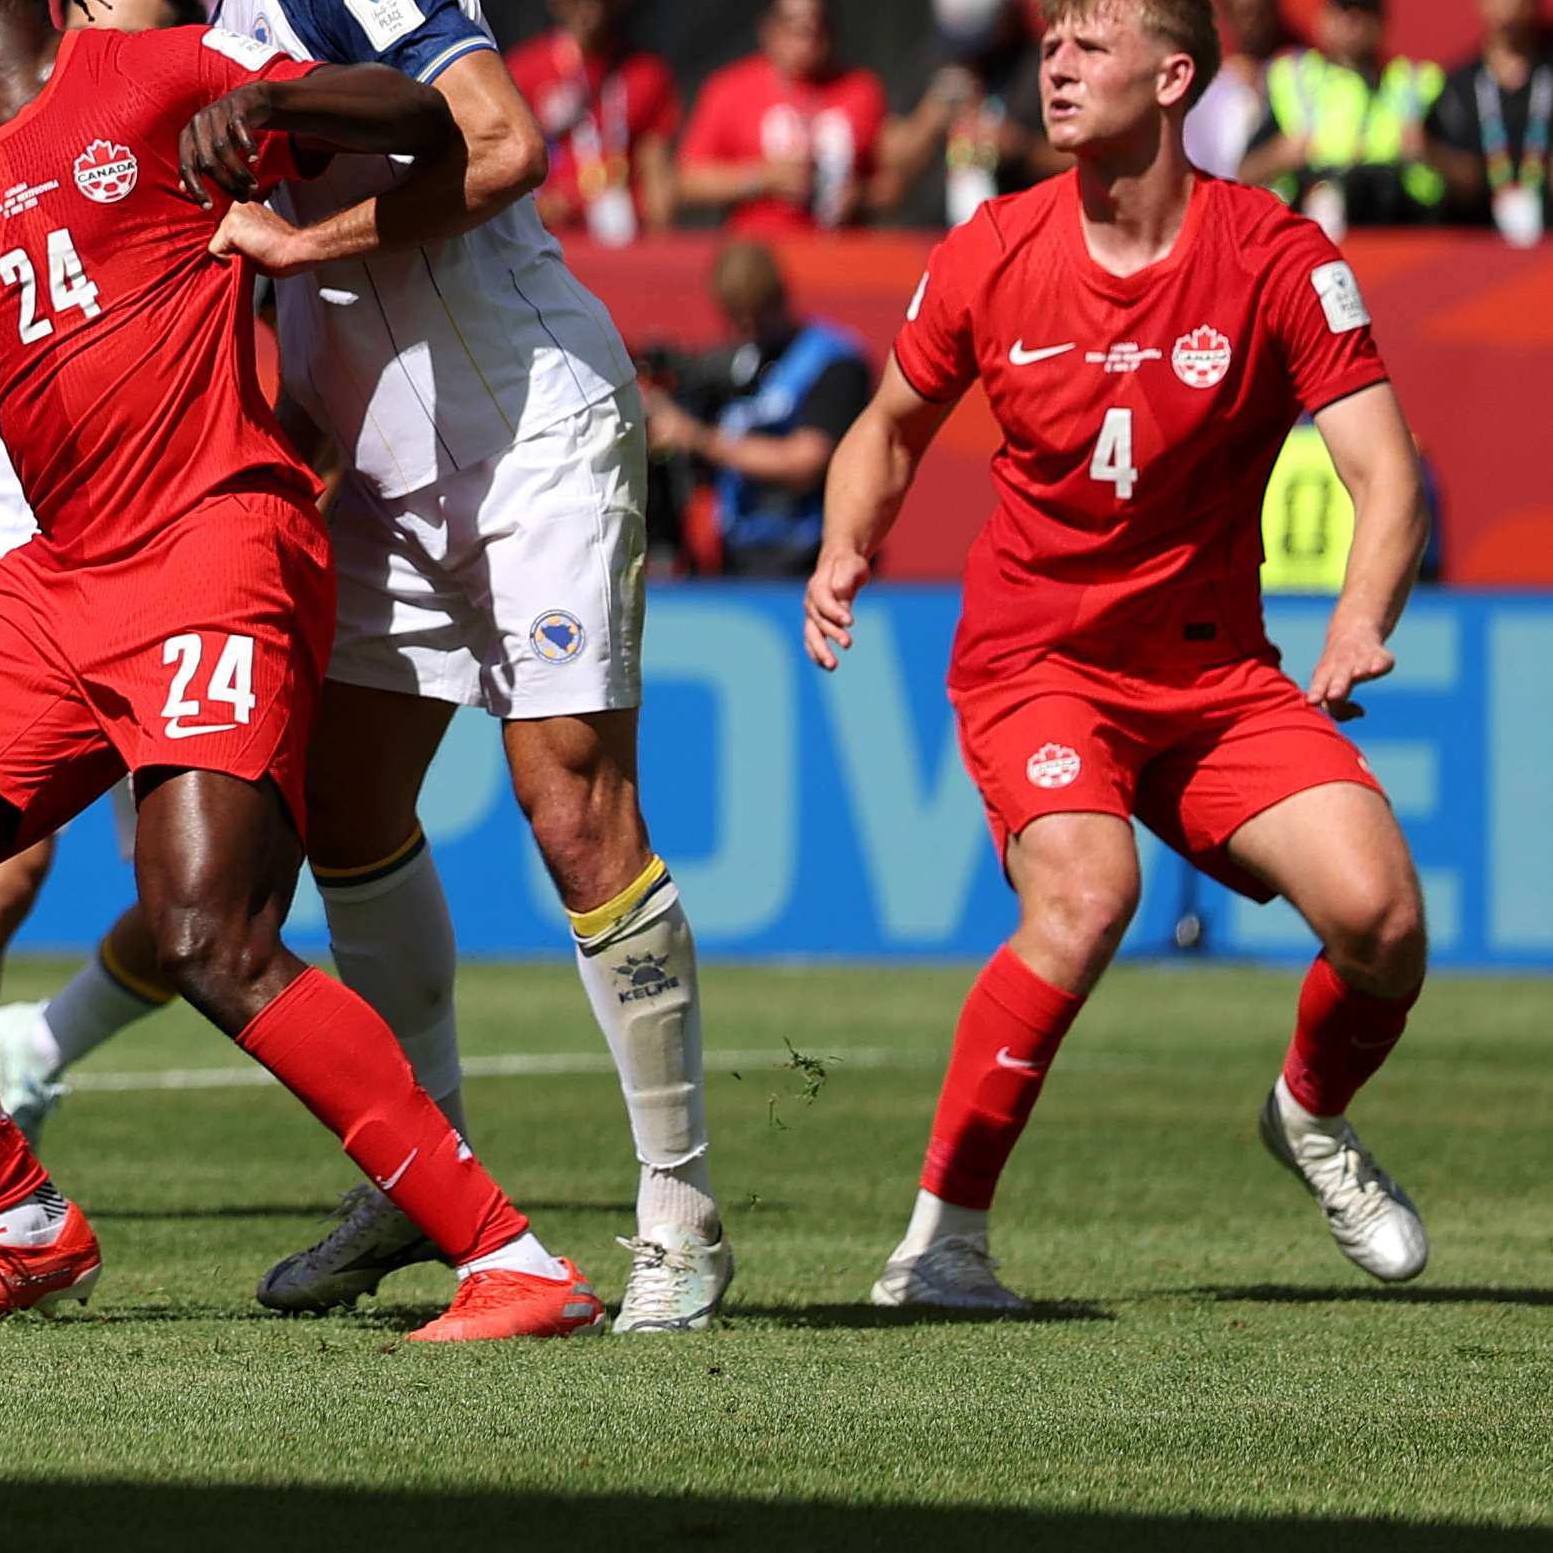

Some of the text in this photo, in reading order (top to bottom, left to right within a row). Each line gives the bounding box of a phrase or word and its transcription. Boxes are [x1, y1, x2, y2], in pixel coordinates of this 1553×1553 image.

[77, 161, 136, 183] CANADA
[1089, 408, 1138, 500] 4
[160, 632, 256, 724] 24
[618, 976, 680, 1004] KELME
